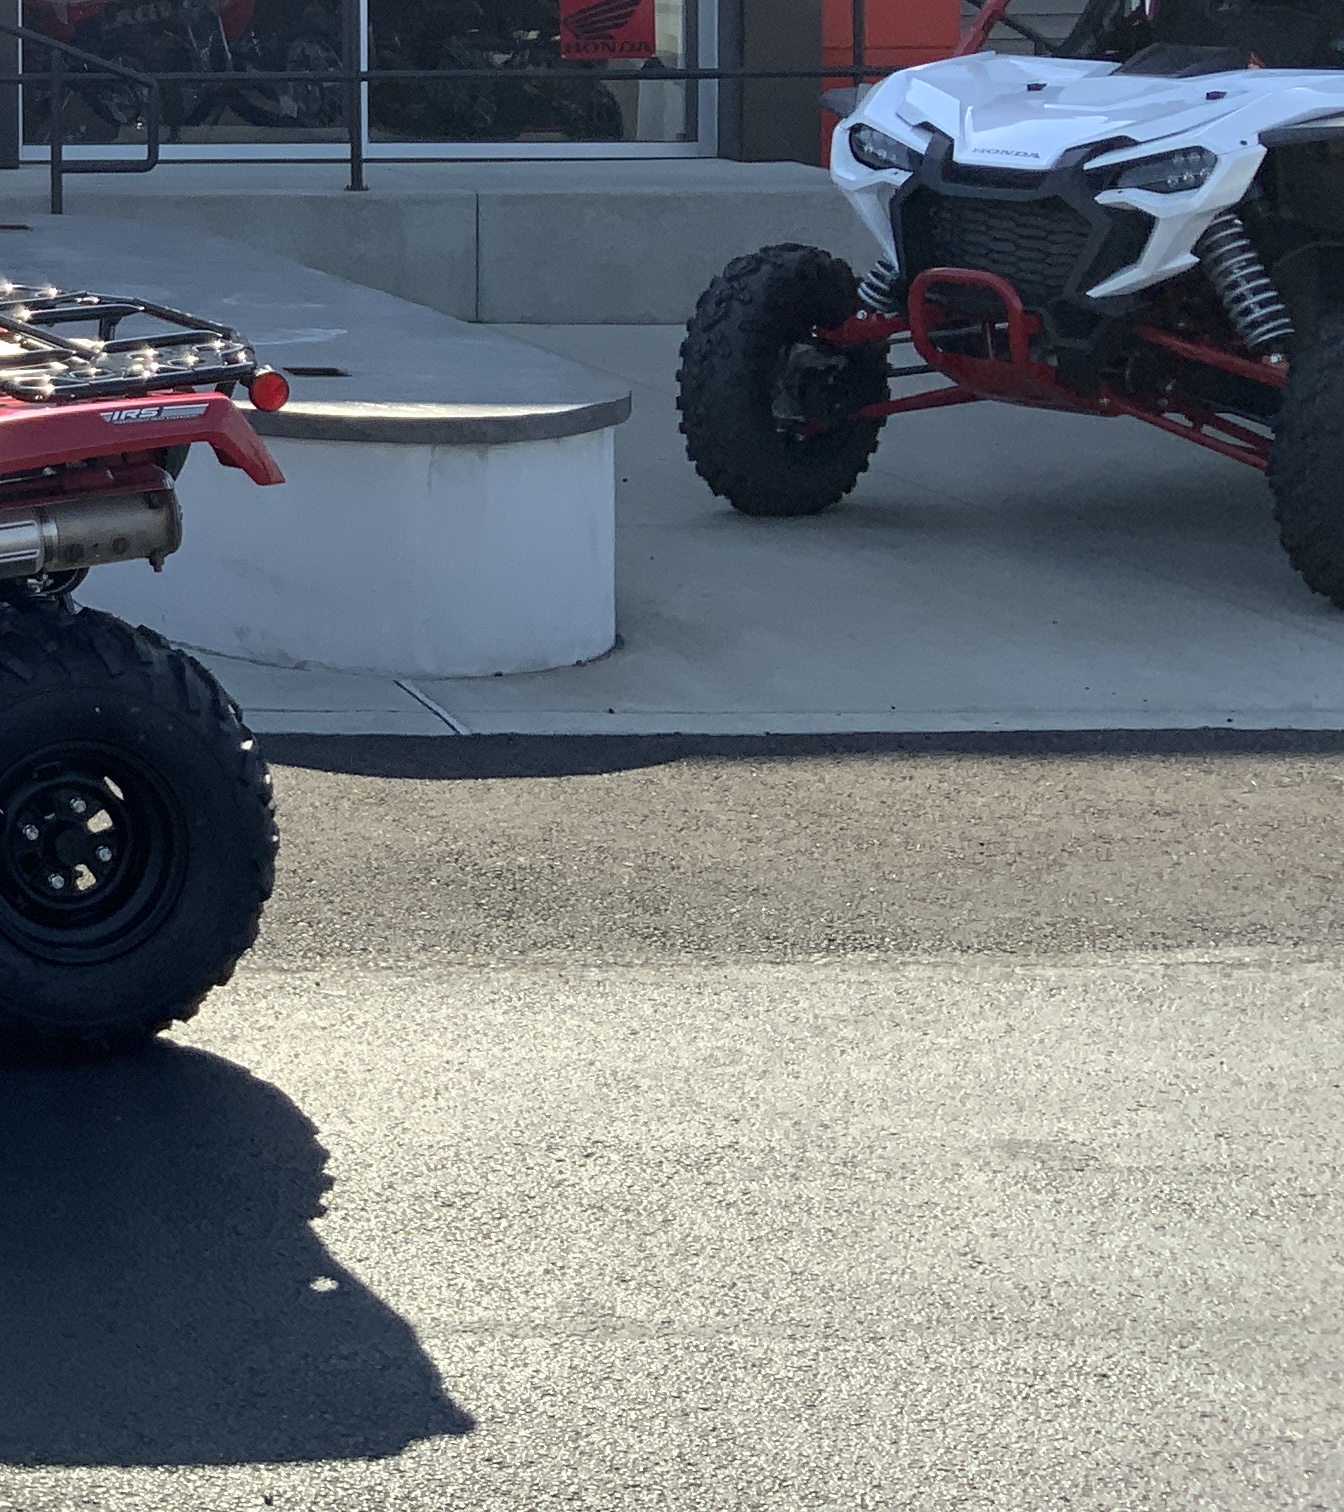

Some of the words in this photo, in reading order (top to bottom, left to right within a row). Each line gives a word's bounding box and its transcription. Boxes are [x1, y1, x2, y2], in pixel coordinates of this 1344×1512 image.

[564, 41, 652, 54] HONDA
[972, 148, 1040, 159] HONDA
[112, 407, 160, 421] IRS
